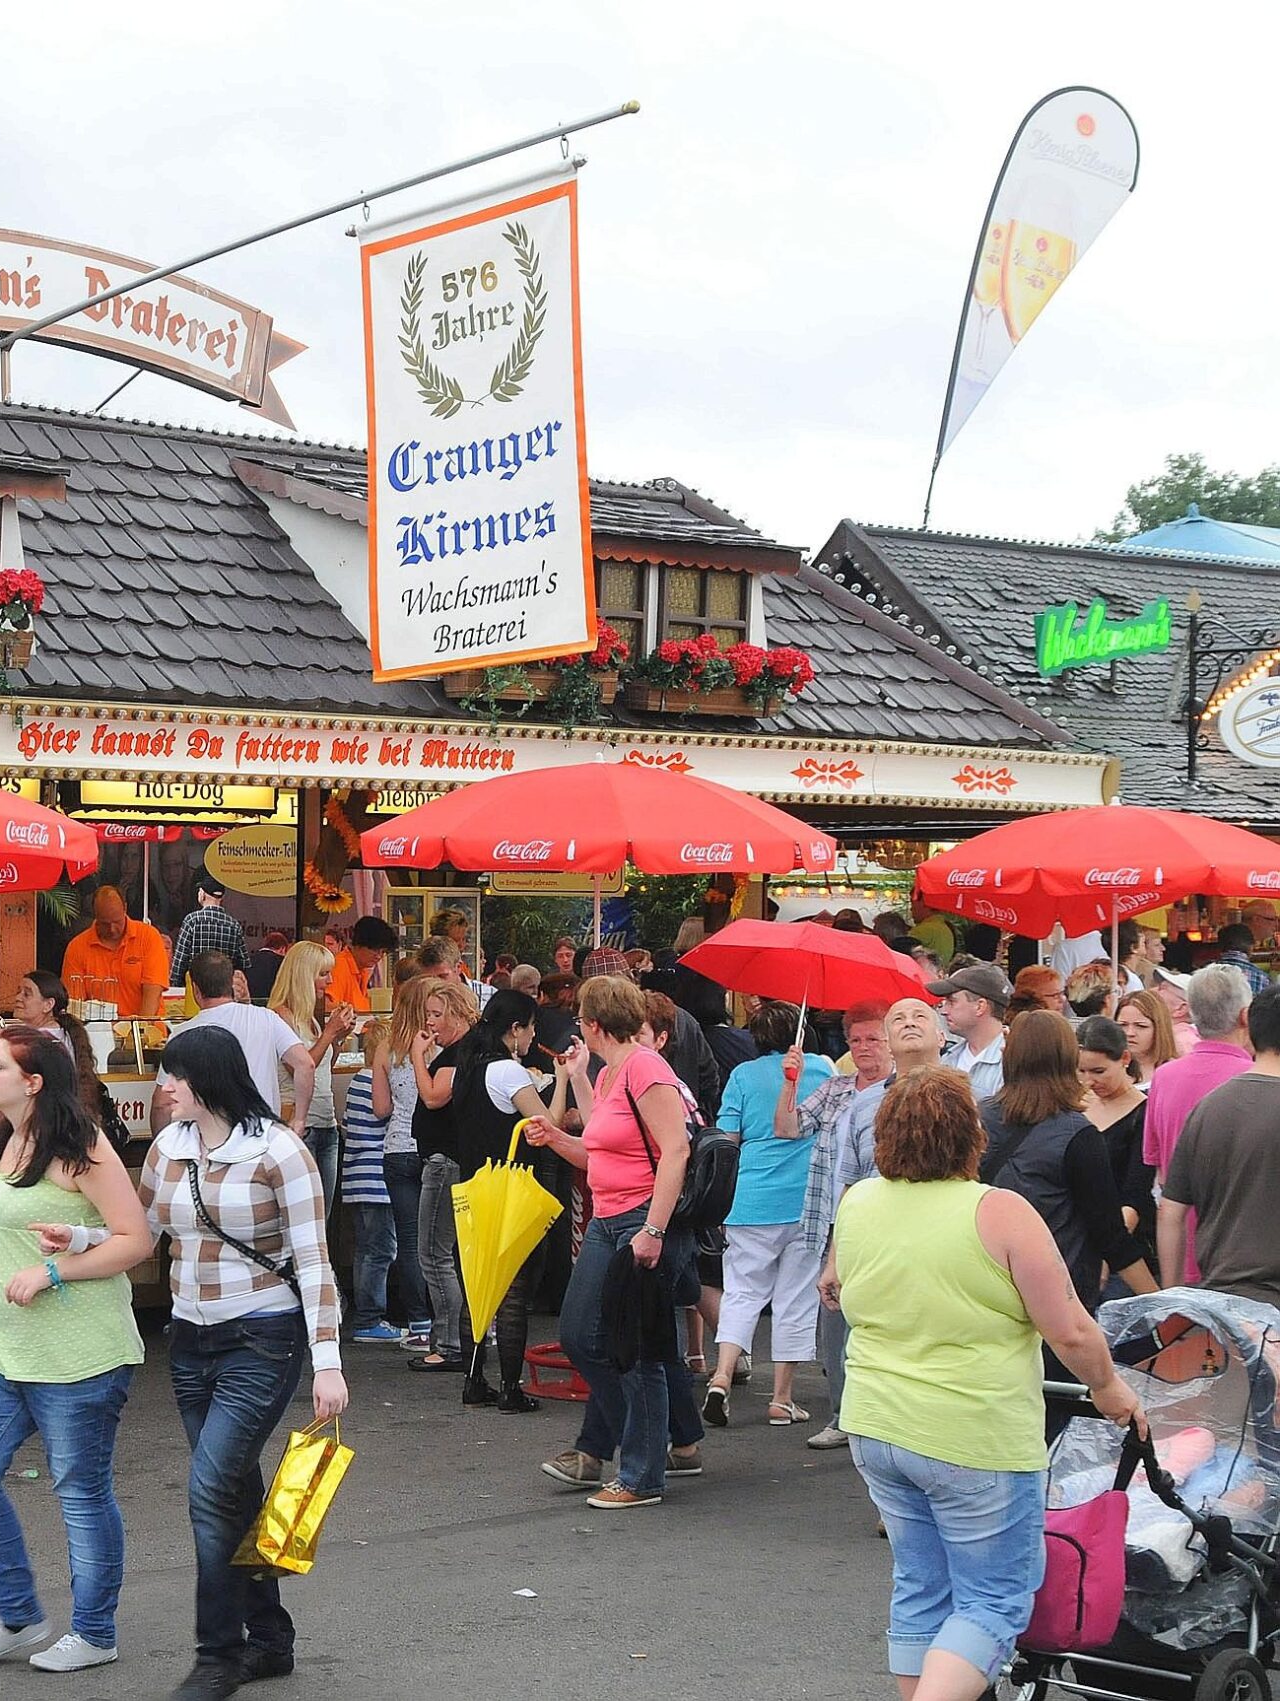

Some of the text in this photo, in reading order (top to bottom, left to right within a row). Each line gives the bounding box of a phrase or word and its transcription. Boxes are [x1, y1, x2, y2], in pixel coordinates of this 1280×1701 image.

[441, 260, 499, 303] 576
[431, 300, 515, 349] Jahre
[388, 420, 563, 493] Cranger
[396, 499, 556, 567] Kirmes
[401, 560, 558, 617] Wachsmann's
[433, 612, 528, 654] Braterei
[17, 721, 516, 772] Hier kannst Du futtern wie bei Muttern
[135, 781, 224, 806] Hot-Dog
[6, 820, 49, 845] Coca-Cola
[104, 824, 147, 838] Coca-Cola
[218, 841, 297, 858] Feinschmecker-Tell
[378, 836, 408, 856] Coca-Cola
[493, 840, 555, 860] Coca-Cola
[680, 843, 733, 862] Coca-Cola
[947, 869, 988, 886] Coca-Cola
[1084, 868, 1142, 886] Coca-Cola
